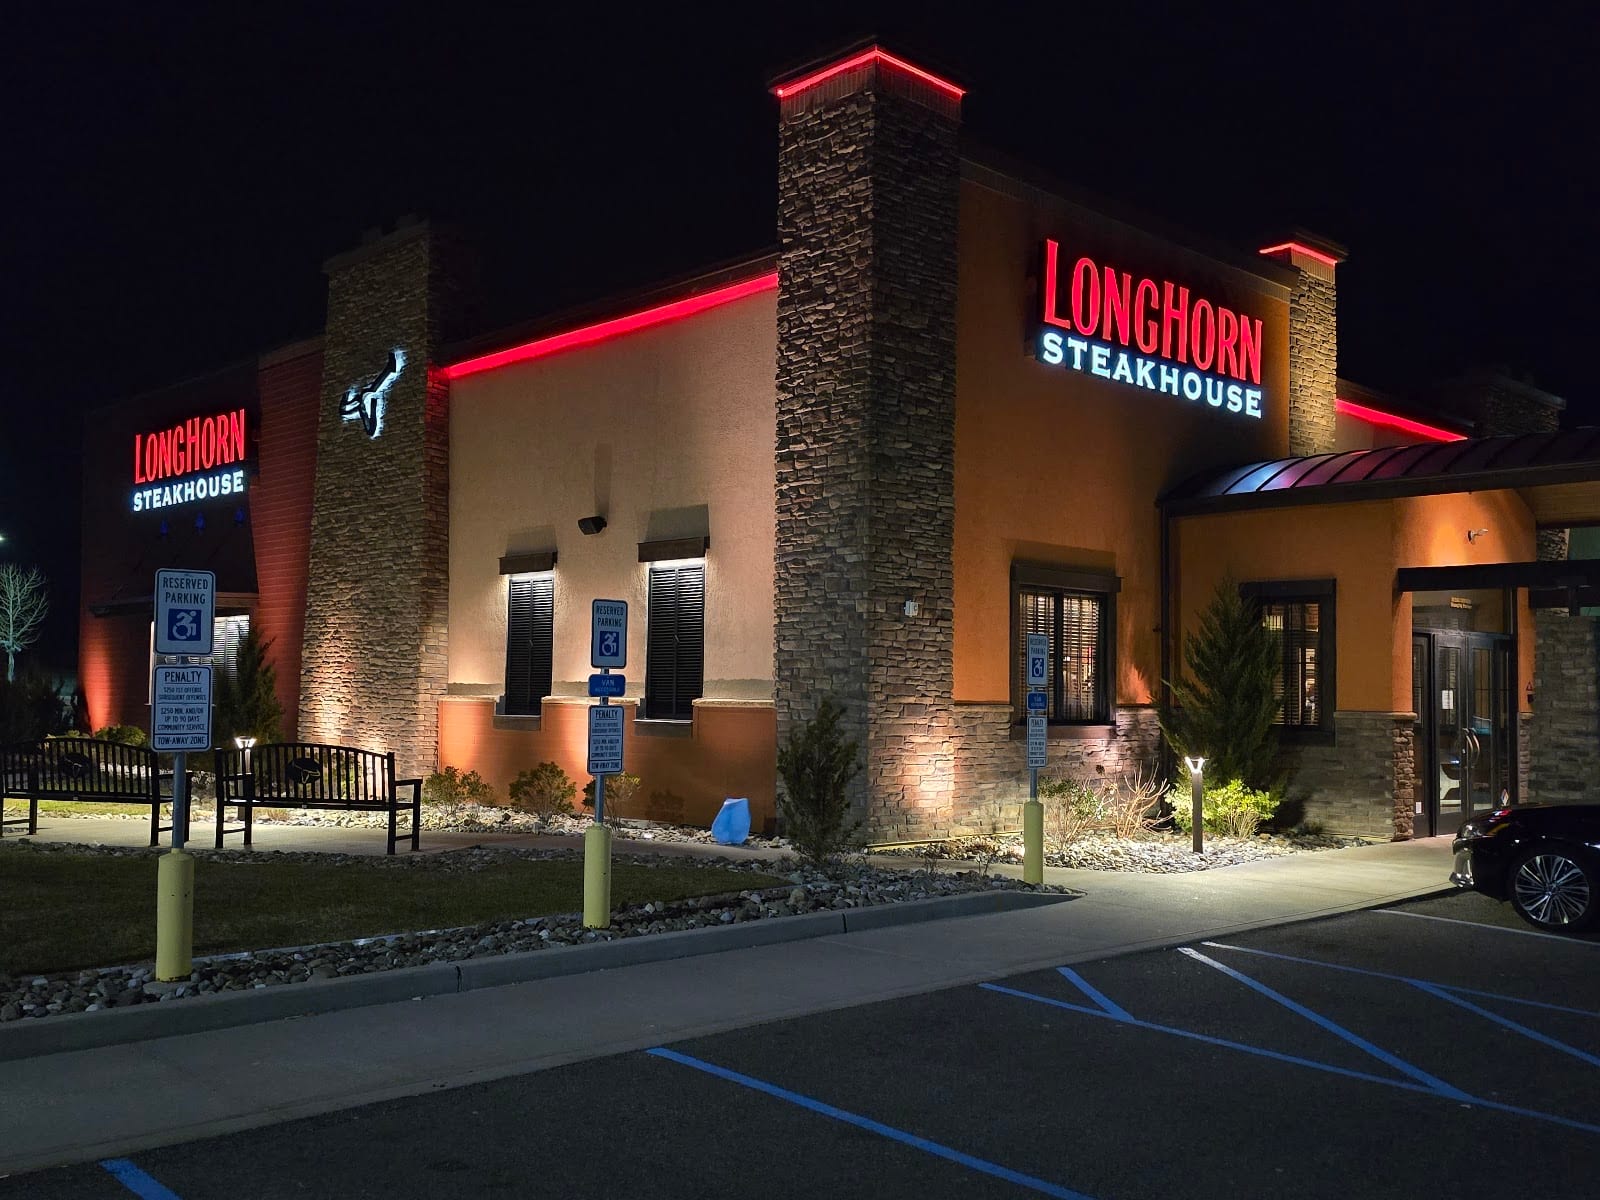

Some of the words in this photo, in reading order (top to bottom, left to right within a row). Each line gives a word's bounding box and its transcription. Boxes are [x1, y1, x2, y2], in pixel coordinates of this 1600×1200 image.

[1044, 239, 1263, 384] LONGHORN
[1043, 332, 1262, 418] STEAKHOUSE
[135, 408, 245, 484] LONGHORN
[133, 470, 244, 512] STEAKHOUSE
[163, 577, 208, 590] RESERVED
[165, 592, 206, 605] PARKING
[596, 605, 624, 616] RESERVED
[597, 617, 622, 628] PARKING
[164, 671, 202, 683] PENALTY
[602, 679, 615, 687] VAN
[172, 715, 179, 723] TO
[187, 715, 200, 723] DAYS
[595, 709, 618, 719] PENALTY
[158, 736, 188, 745] TOW-AWAY
[190, 735, 206, 744] ZONE
